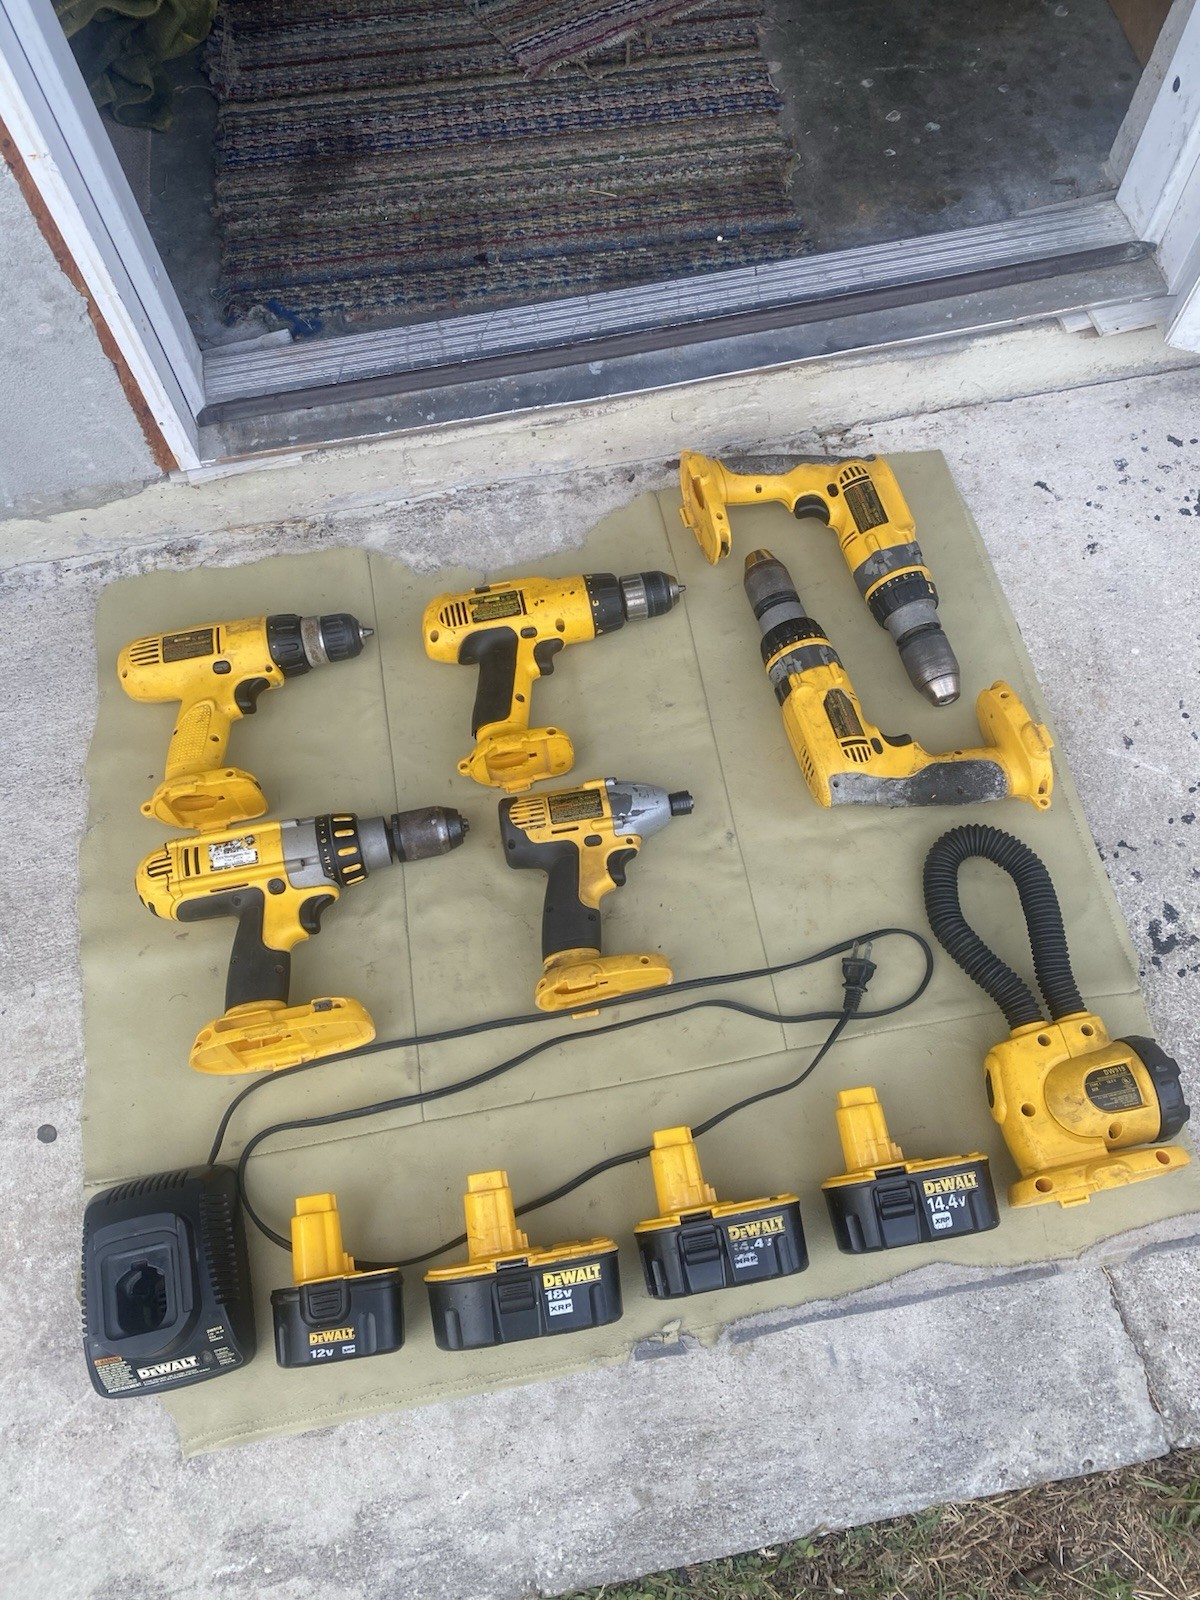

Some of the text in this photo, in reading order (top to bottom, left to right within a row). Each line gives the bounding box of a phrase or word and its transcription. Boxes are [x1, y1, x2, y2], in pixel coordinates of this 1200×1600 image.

[922, 1171, 979, 1197] DEWALT
[727, 1216, 786, 1242] DEWALT
[542, 1263, 602, 1290] DEWALT
[550, 1303, 573, 1313] XRP
[309, 1327, 355, 1346] DEWALT
[136, 1355, 200, 1380] DEWALT
